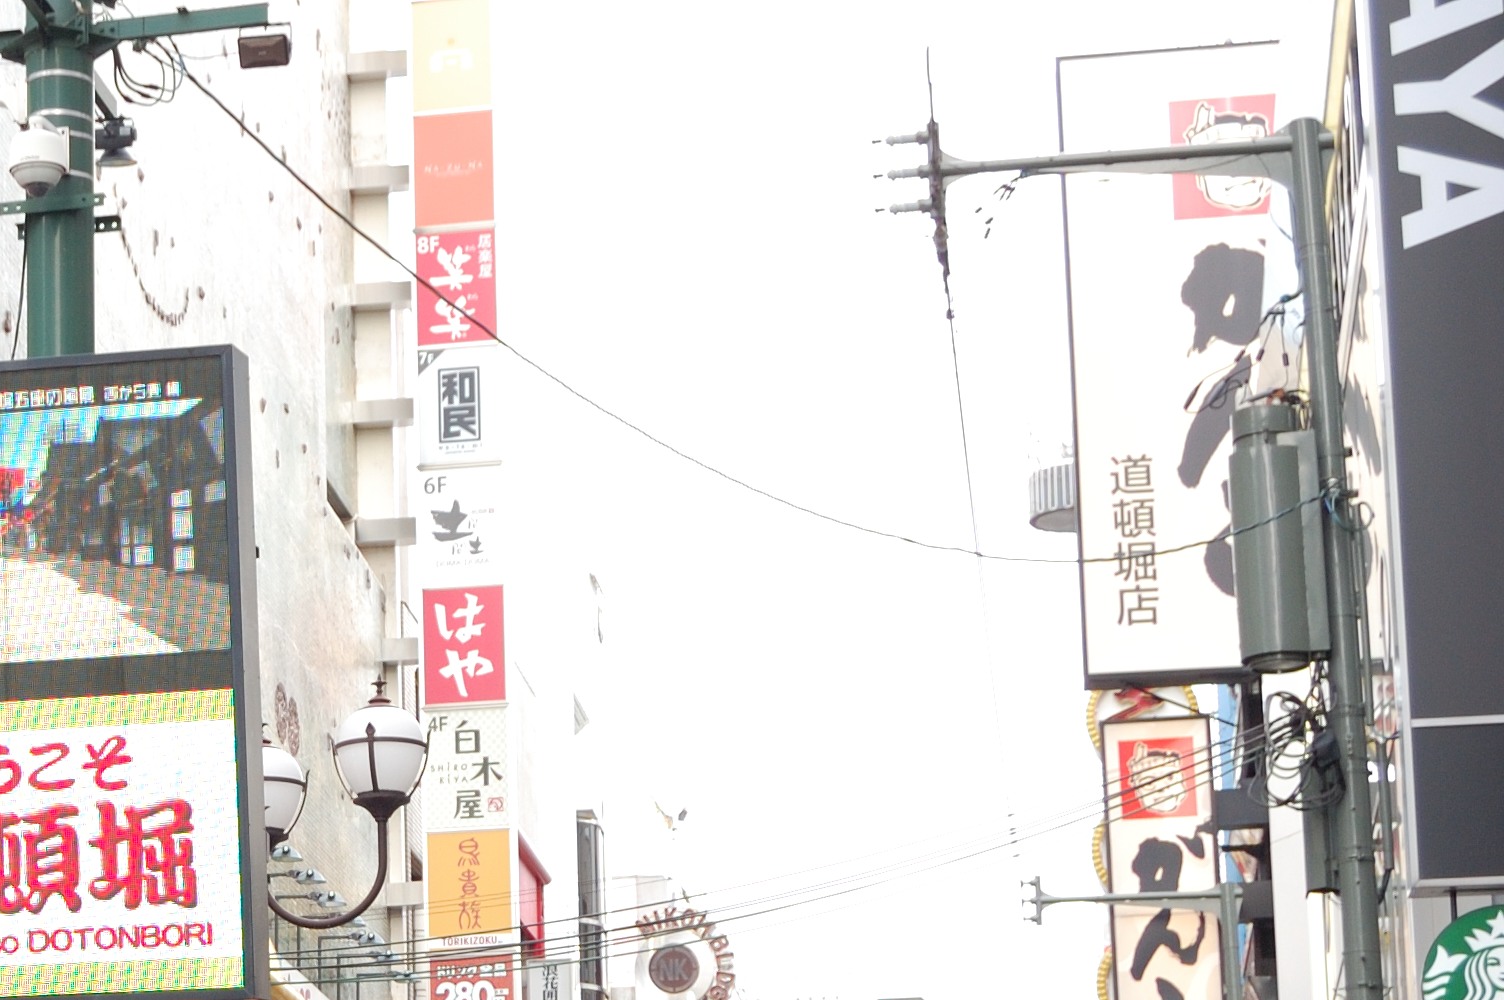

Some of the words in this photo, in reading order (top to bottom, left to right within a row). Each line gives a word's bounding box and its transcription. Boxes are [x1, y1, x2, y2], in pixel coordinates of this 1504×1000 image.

[417, 236, 439, 254] 8F
[442, 370, 477, 439] 和民
[424, 476, 447, 494] 6F
[1110, 455, 1160, 627] 道頓堀店
[434, 593, 494, 698] はや
[429, 716, 448, 732] 4F
[453, 720, 503, 819] 白木屋
[28, 922, 214, 954] DOTONBORI
